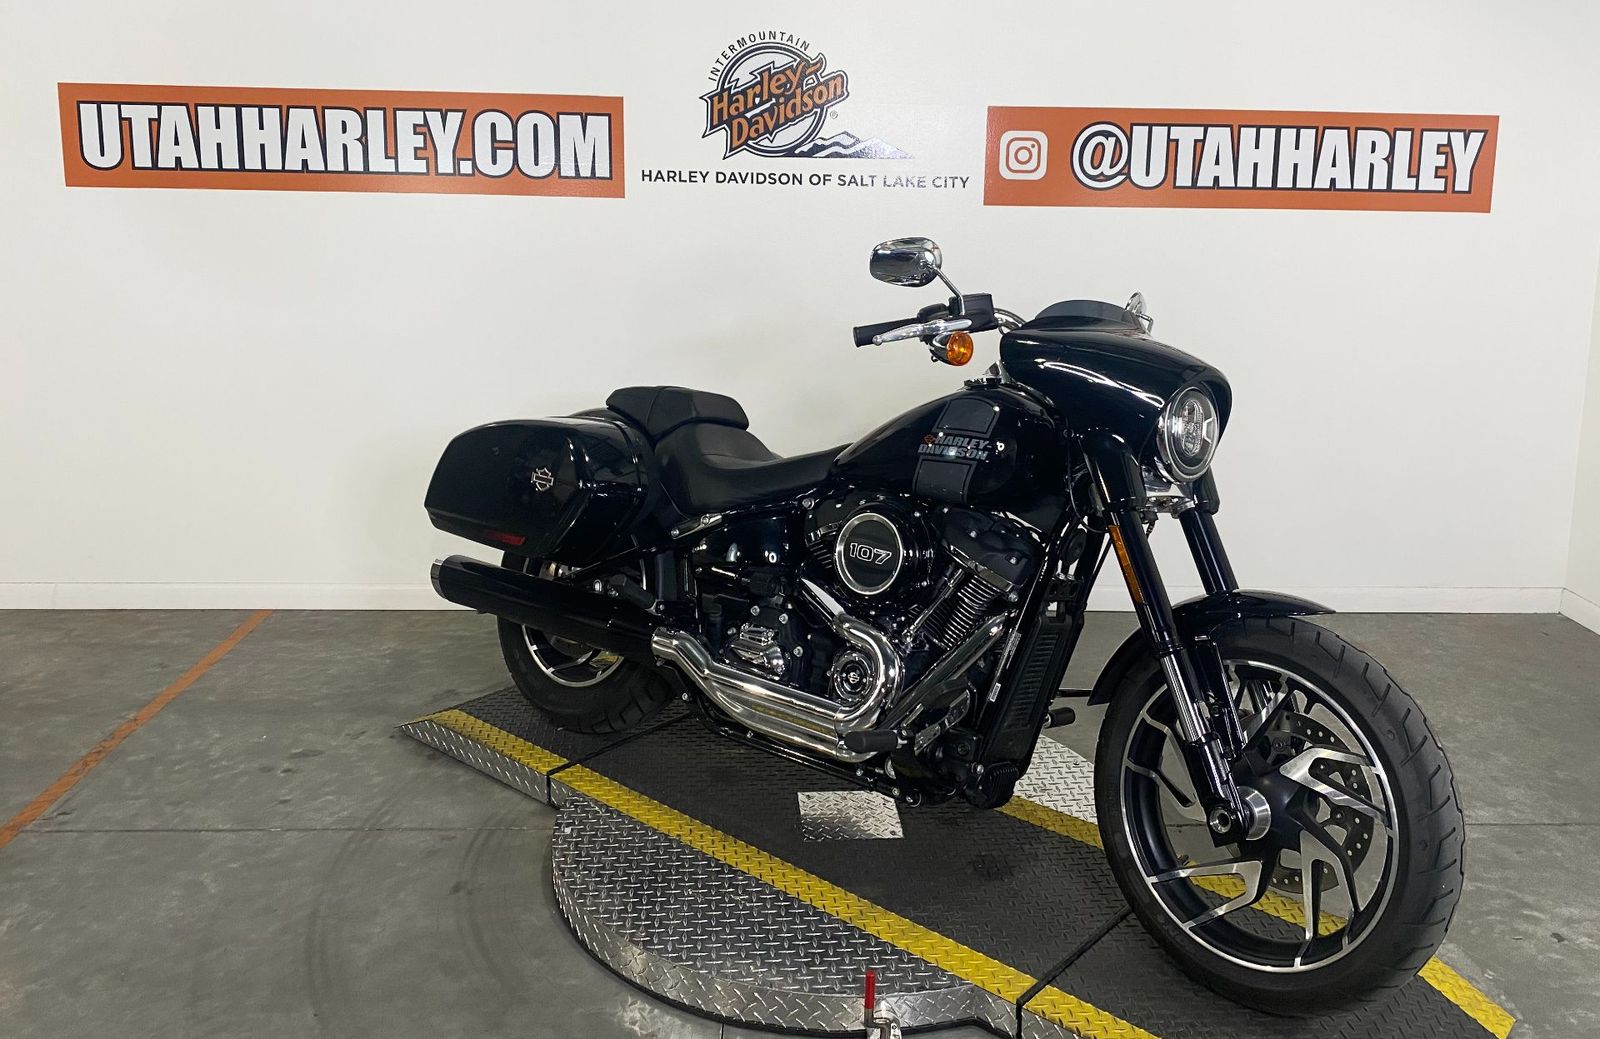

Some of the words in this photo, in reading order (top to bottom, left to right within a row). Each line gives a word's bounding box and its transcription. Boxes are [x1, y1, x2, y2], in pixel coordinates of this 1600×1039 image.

[708, 30, 810, 82] INTERMOUNTAIN
[76, 100, 613, 181] UTAHHARLEY.COM
[731, 75, 844, 149] Davidson
[641, 169, 710, 183] HARLEY
[715, 171, 803, 185] DAVIDSON
[808, 173, 833, 186] OF
[837, 174, 877, 187] SALT
[883, 175, 927, 188] LAKE
[932, 176, 970, 189] CITY
[1070, 121, 1489, 195] @UTAHHARLEY
[849, 542, 892, 565] 107
